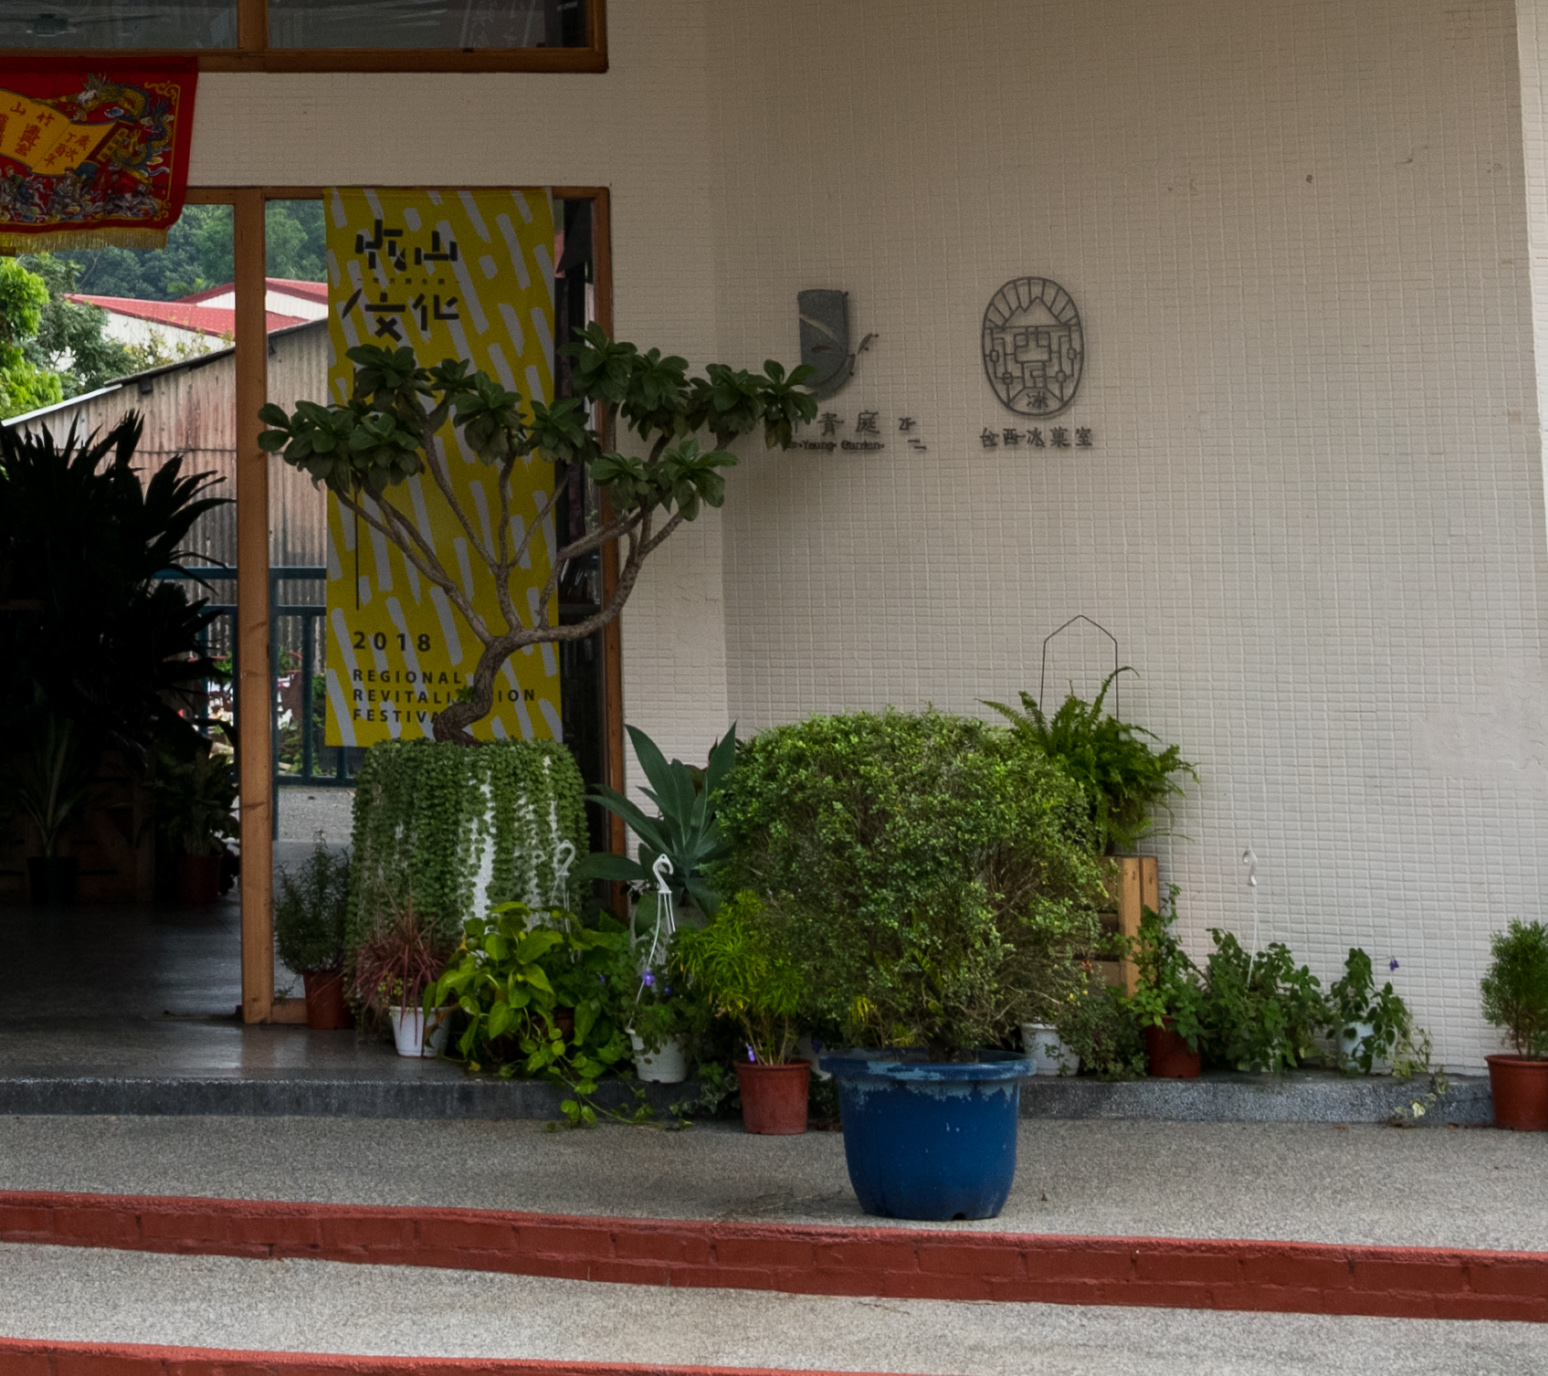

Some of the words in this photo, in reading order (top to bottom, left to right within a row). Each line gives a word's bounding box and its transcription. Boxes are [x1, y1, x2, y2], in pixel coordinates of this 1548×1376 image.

[353, 631, 431, 652] 2018
[353, 668, 463, 685] REGIONAL
[353, 688, 536, 705] REVITALIION
